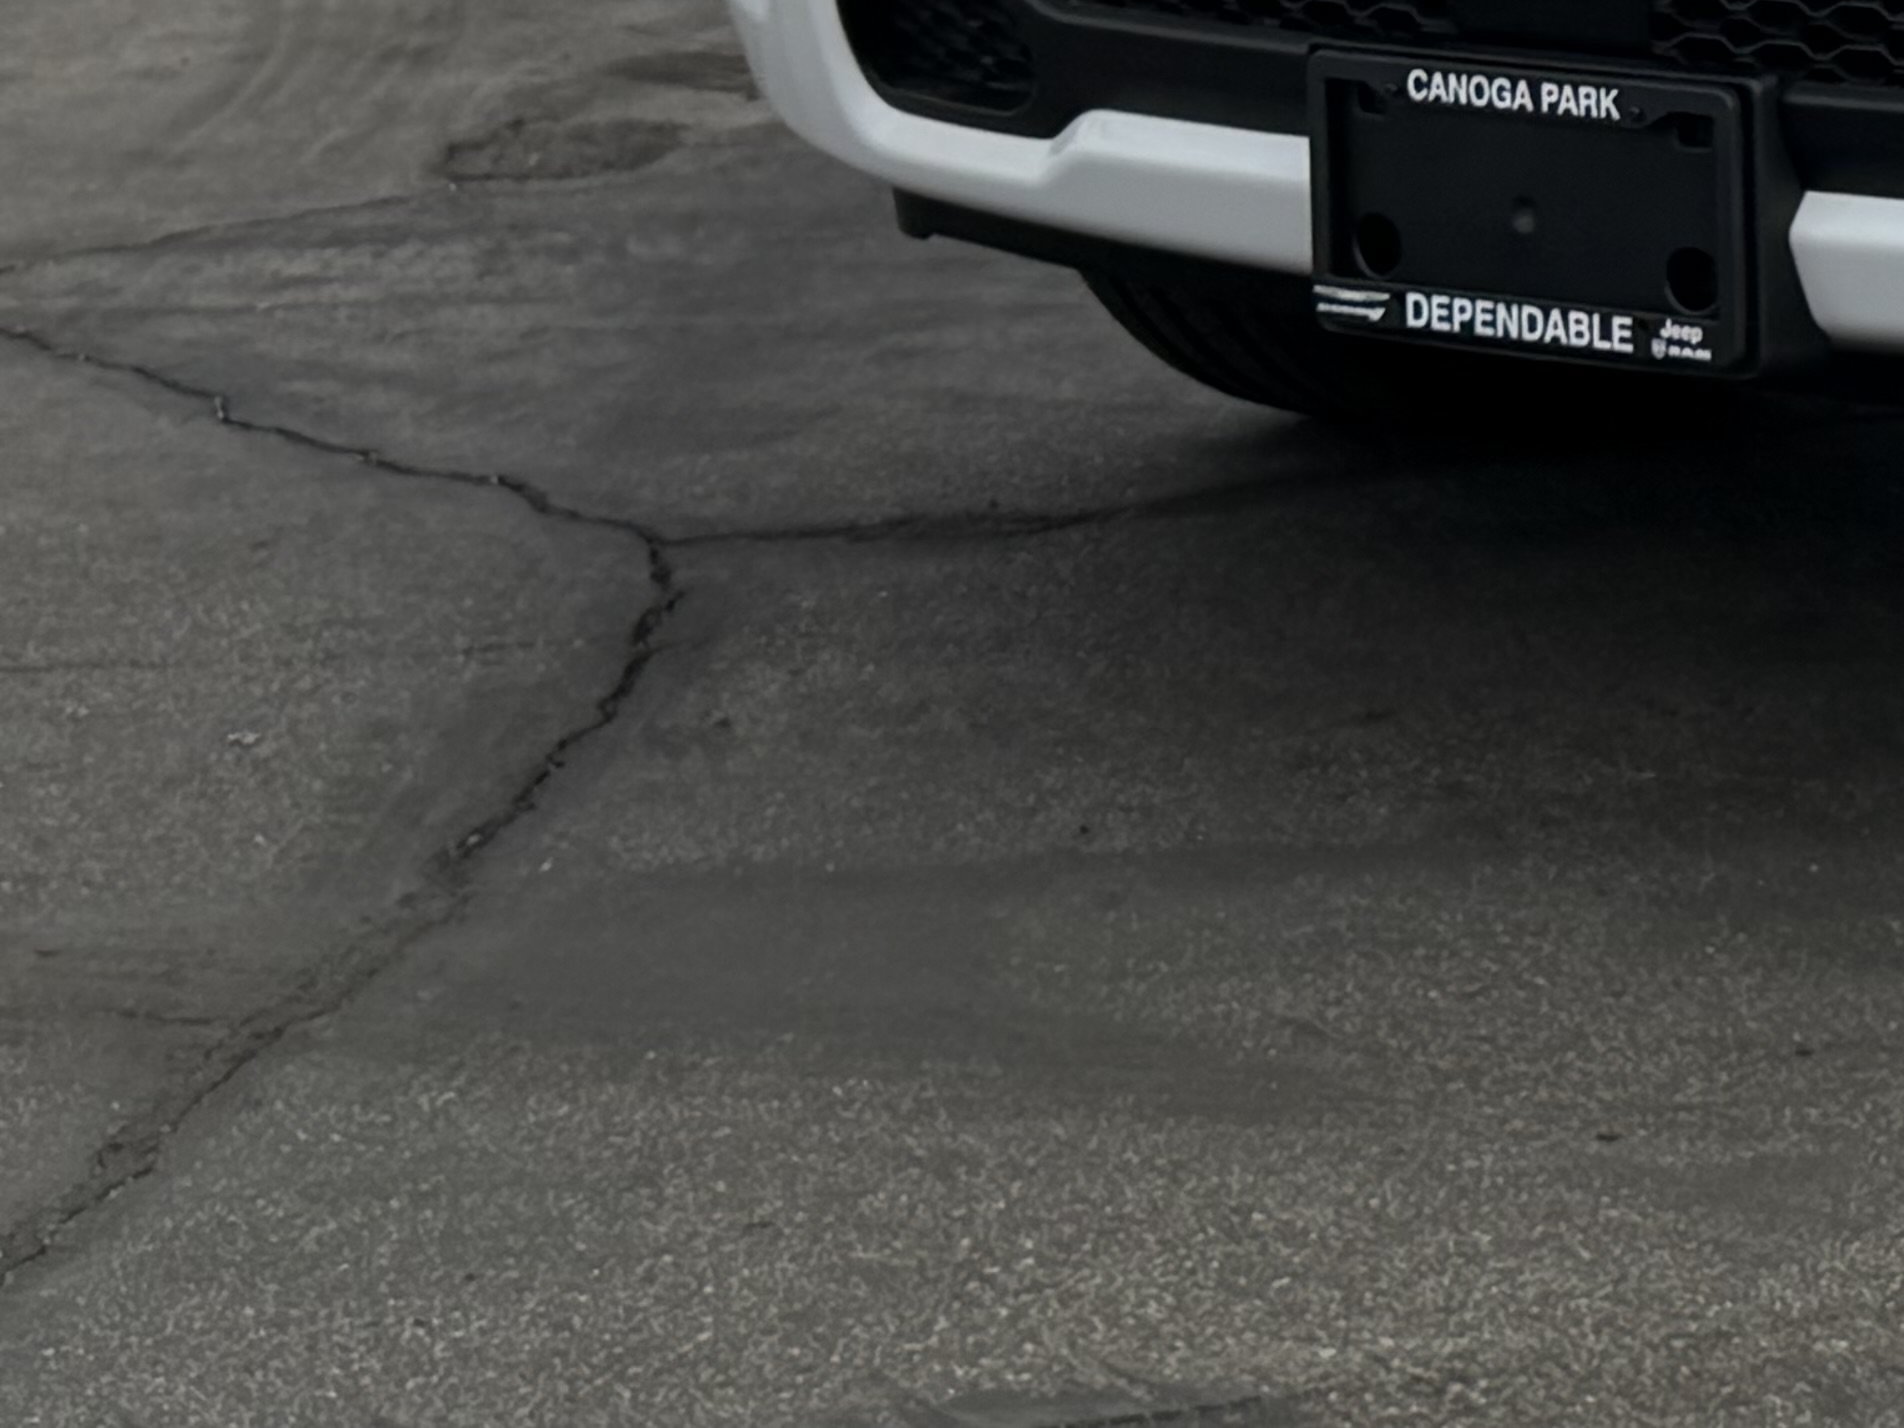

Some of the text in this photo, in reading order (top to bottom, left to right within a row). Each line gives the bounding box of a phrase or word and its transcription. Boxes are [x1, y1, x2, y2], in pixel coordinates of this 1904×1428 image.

[1406, 68, 1621, 120] CANOGA PARK
[1405, 290, 1635, 354] DEPENDABLE
[1659, 318, 1704, 345] Jeep
